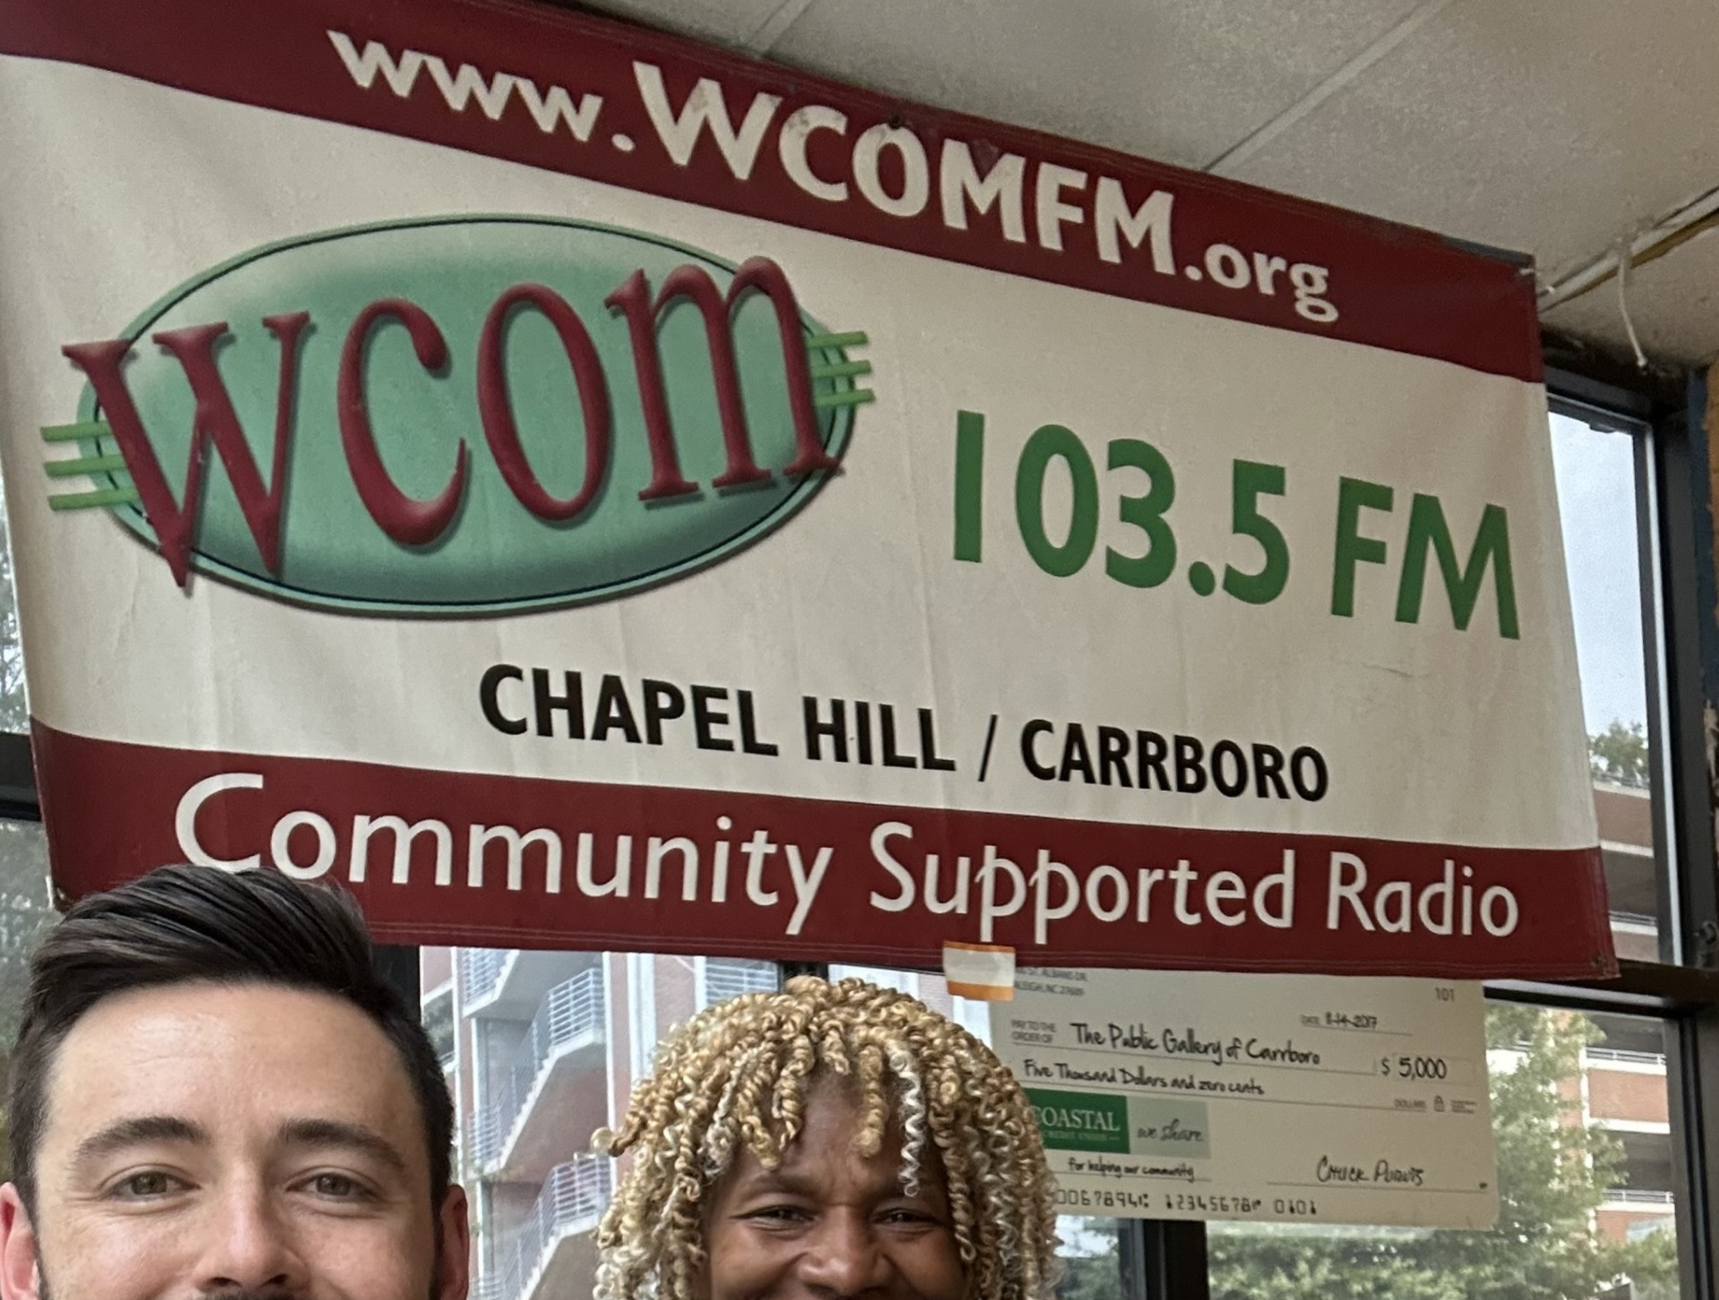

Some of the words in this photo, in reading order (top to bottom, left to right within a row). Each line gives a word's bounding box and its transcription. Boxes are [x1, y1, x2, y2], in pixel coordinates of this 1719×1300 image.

[953, 409, 1290, 605] 103.5
[1330, 475, 1521, 641] FM
[479, 663, 779, 757] CHAPEL
[804, 695, 957, 773] HILL
[1019, 717, 1330, 802] CARRBORO
[174, 771, 834, 936] Community
[868, 820, 1296, 945] Supported
[1325, 850, 1520, 938] Radio
[1434, 987, 1455, 1002] 101
[1011, 1031, 1041, 1042] ORDER
[1039, 1022, 1057, 1033] THE
[1069, 1022, 1106, 1045] The
[1107, 1022, 1160, 1050] Public
[1162, 1027, 1223, 1067] Gallery
[1225, 1037, 1243, 1060] of
[1245, 1038, 1321, 1065] Carrboro
[1023, 1058, 1053, 1078] Five
[1054, 1062, 1118, 1083] Thousand
[1118, 1065, 1168, 1088] Dollars
[1170, 1074, 1197, 1090] and
[1198, 1079, 1227, 1093] zero
[1228, 1078, 1265, 1096] cents
[1380, 1056, 1391, 1077] $
[1398, 1057, 1447, 1081] 5,000
[1067, 1156, 1086, 1172] for
[1087, 1155, 1122, 1179] helping
[1142, 1162, 1195, 1184] community
[1273, 1198, 1317, 1215] 0101
